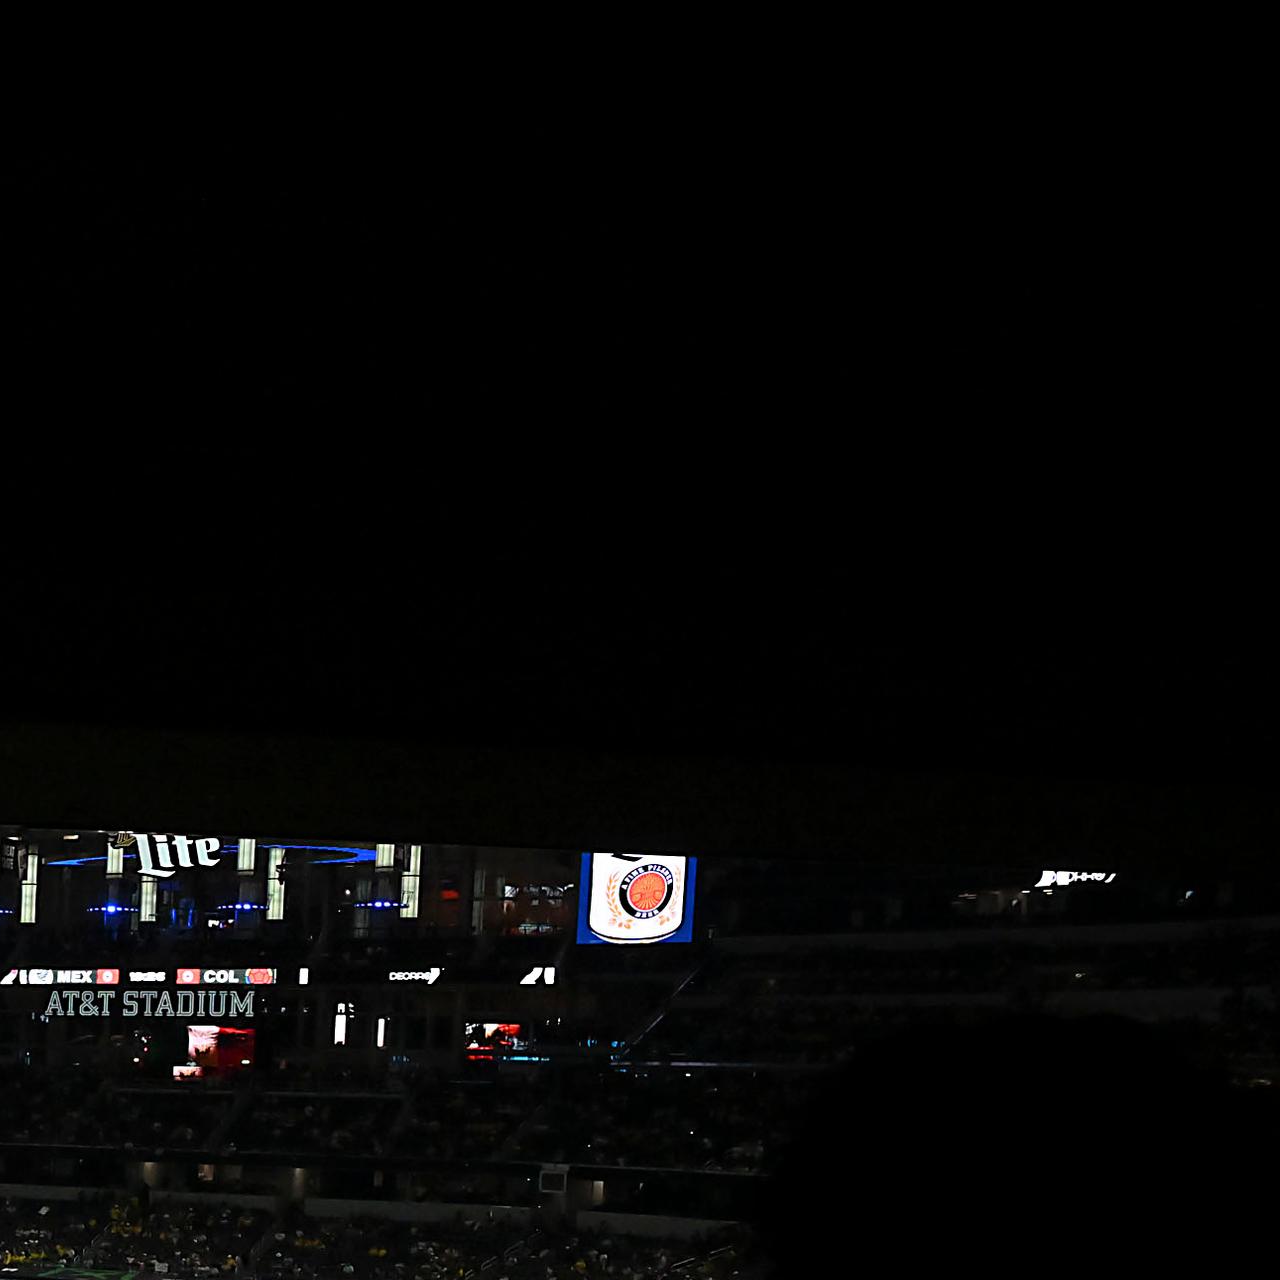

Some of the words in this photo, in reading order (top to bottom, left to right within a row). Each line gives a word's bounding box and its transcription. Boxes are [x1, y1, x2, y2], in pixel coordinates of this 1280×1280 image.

[132, 833, 221, 878] Lite
[57, 970, 93, 983] MEX
[204, 970, 239, 983] COL
[45, 990, 116, 1016] AT&T
[122, 990, 255, 1017] STADIUM
